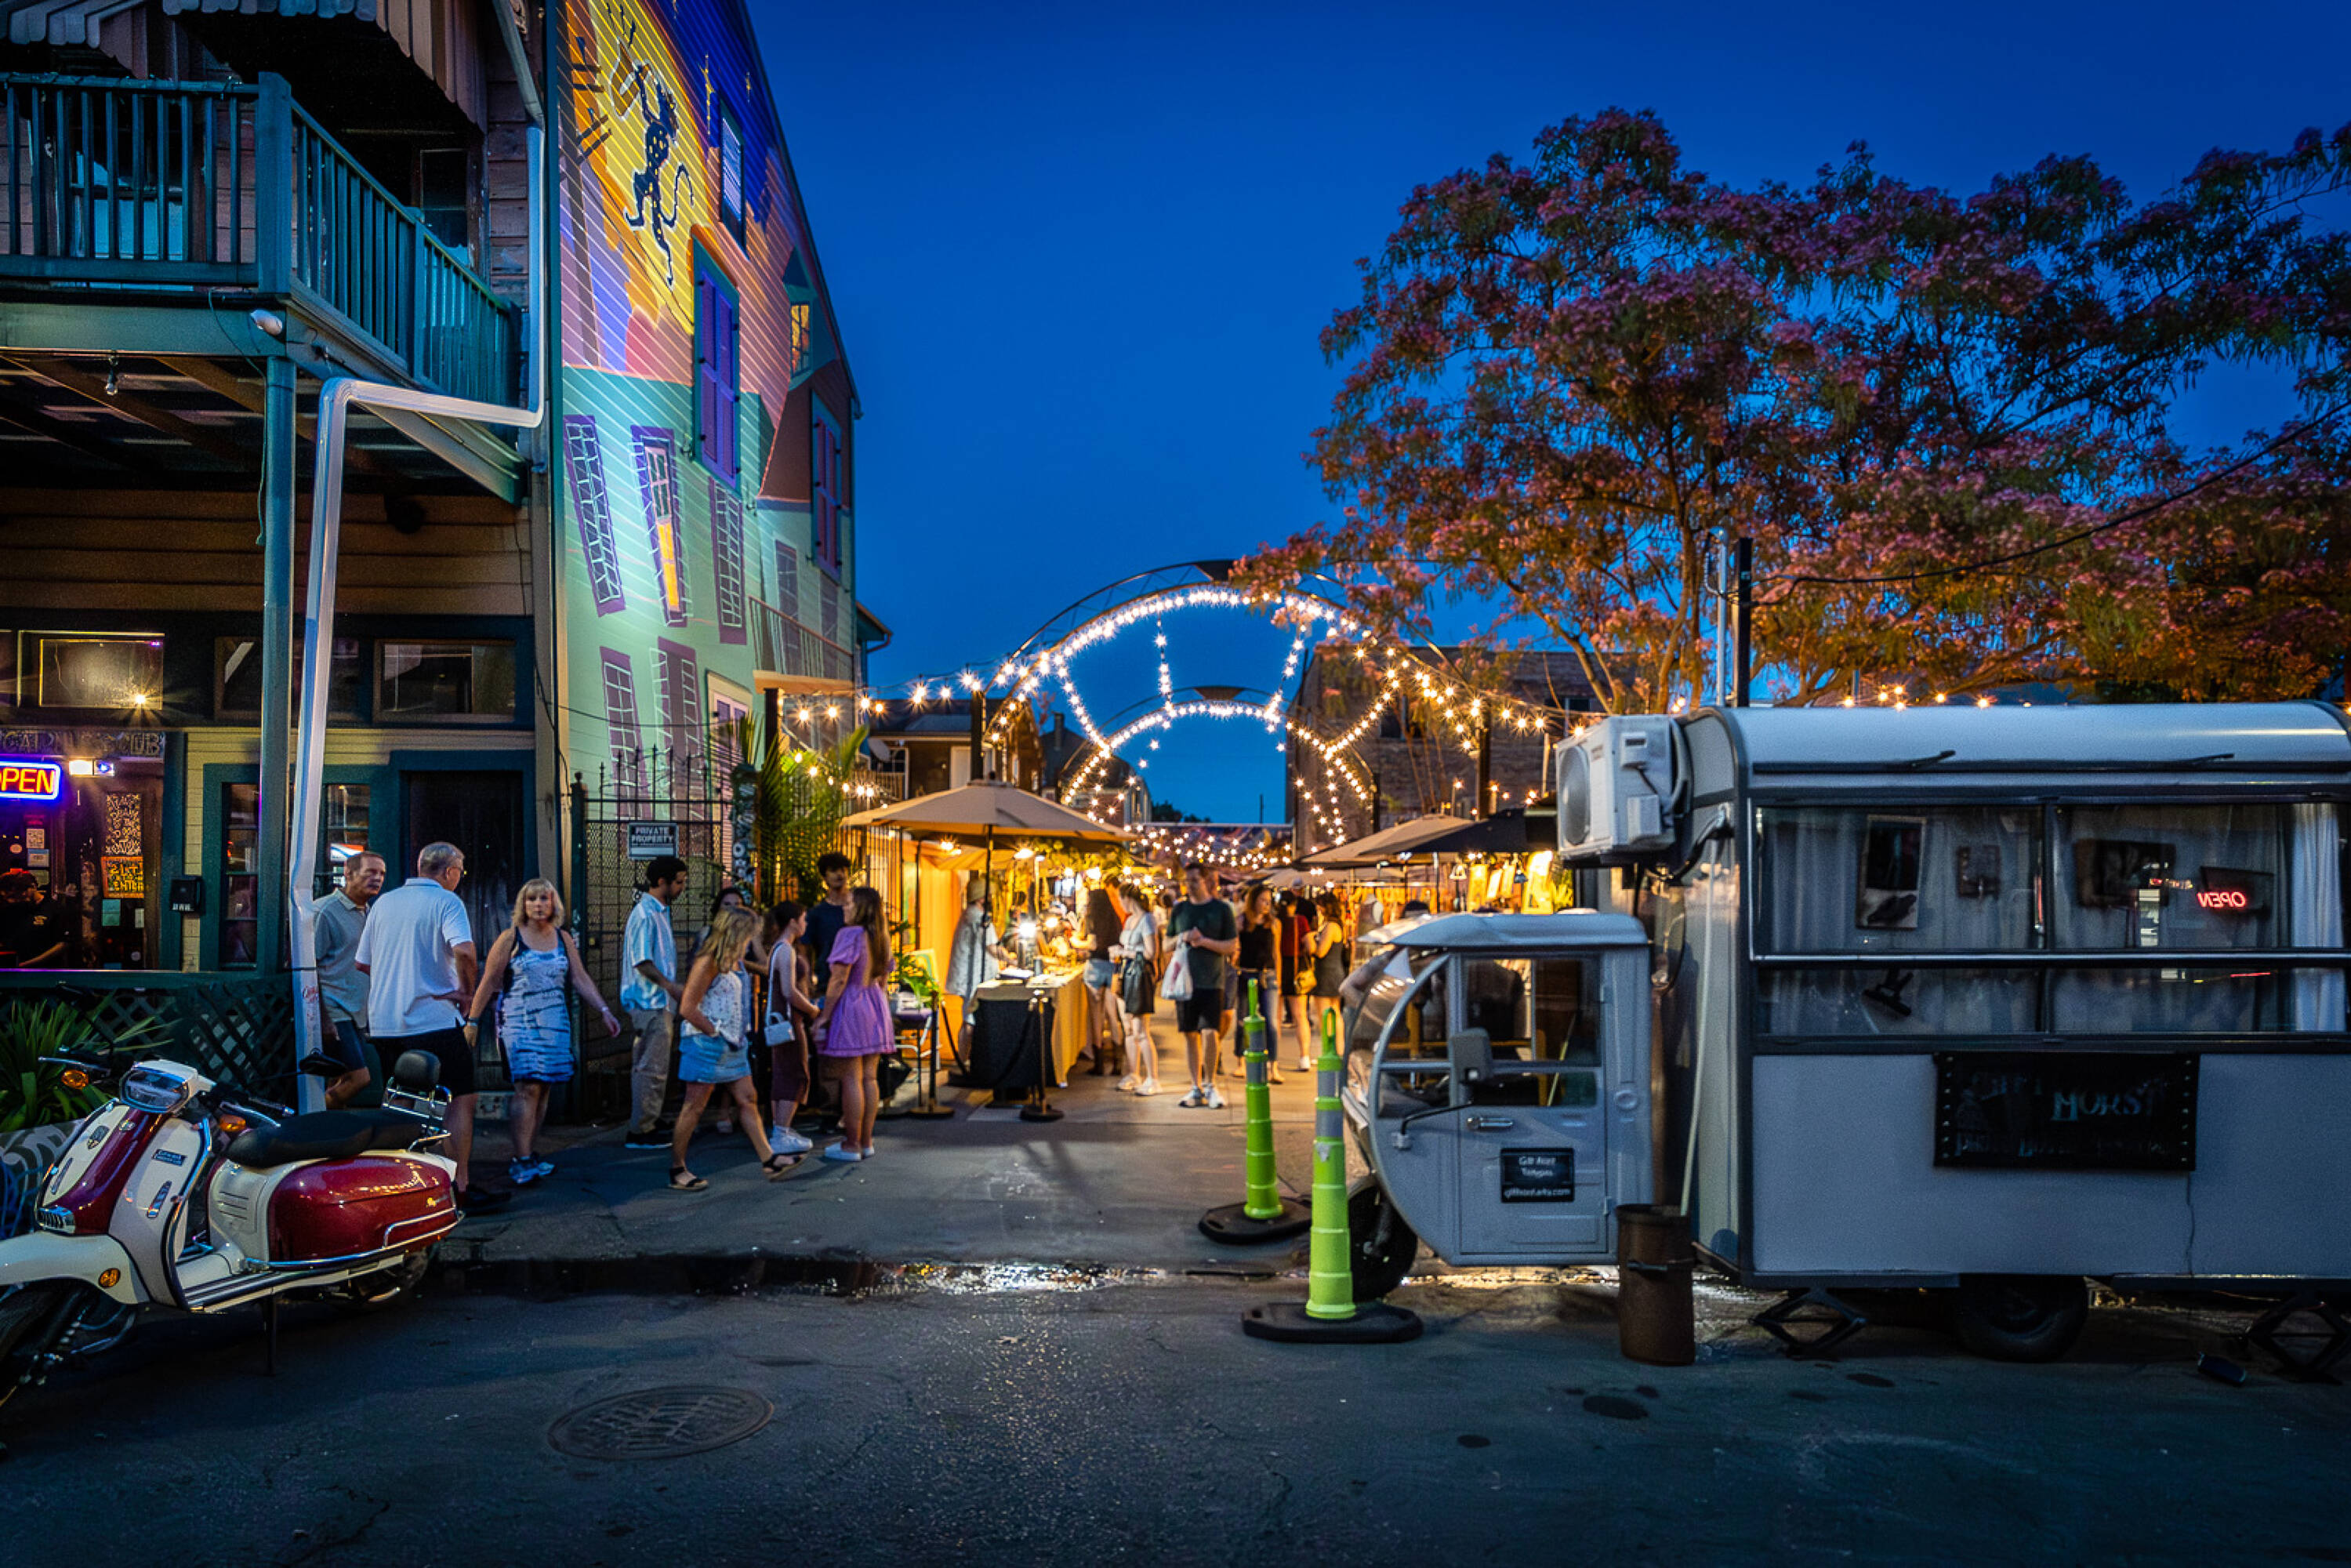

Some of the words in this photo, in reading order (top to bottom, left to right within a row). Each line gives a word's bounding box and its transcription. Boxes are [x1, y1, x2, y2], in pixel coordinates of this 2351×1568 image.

[0, 768, 53, 793] PEN
[635, 826, 669, 835] PRIVATE
[631, 835, 673, 844] PROPERTY
